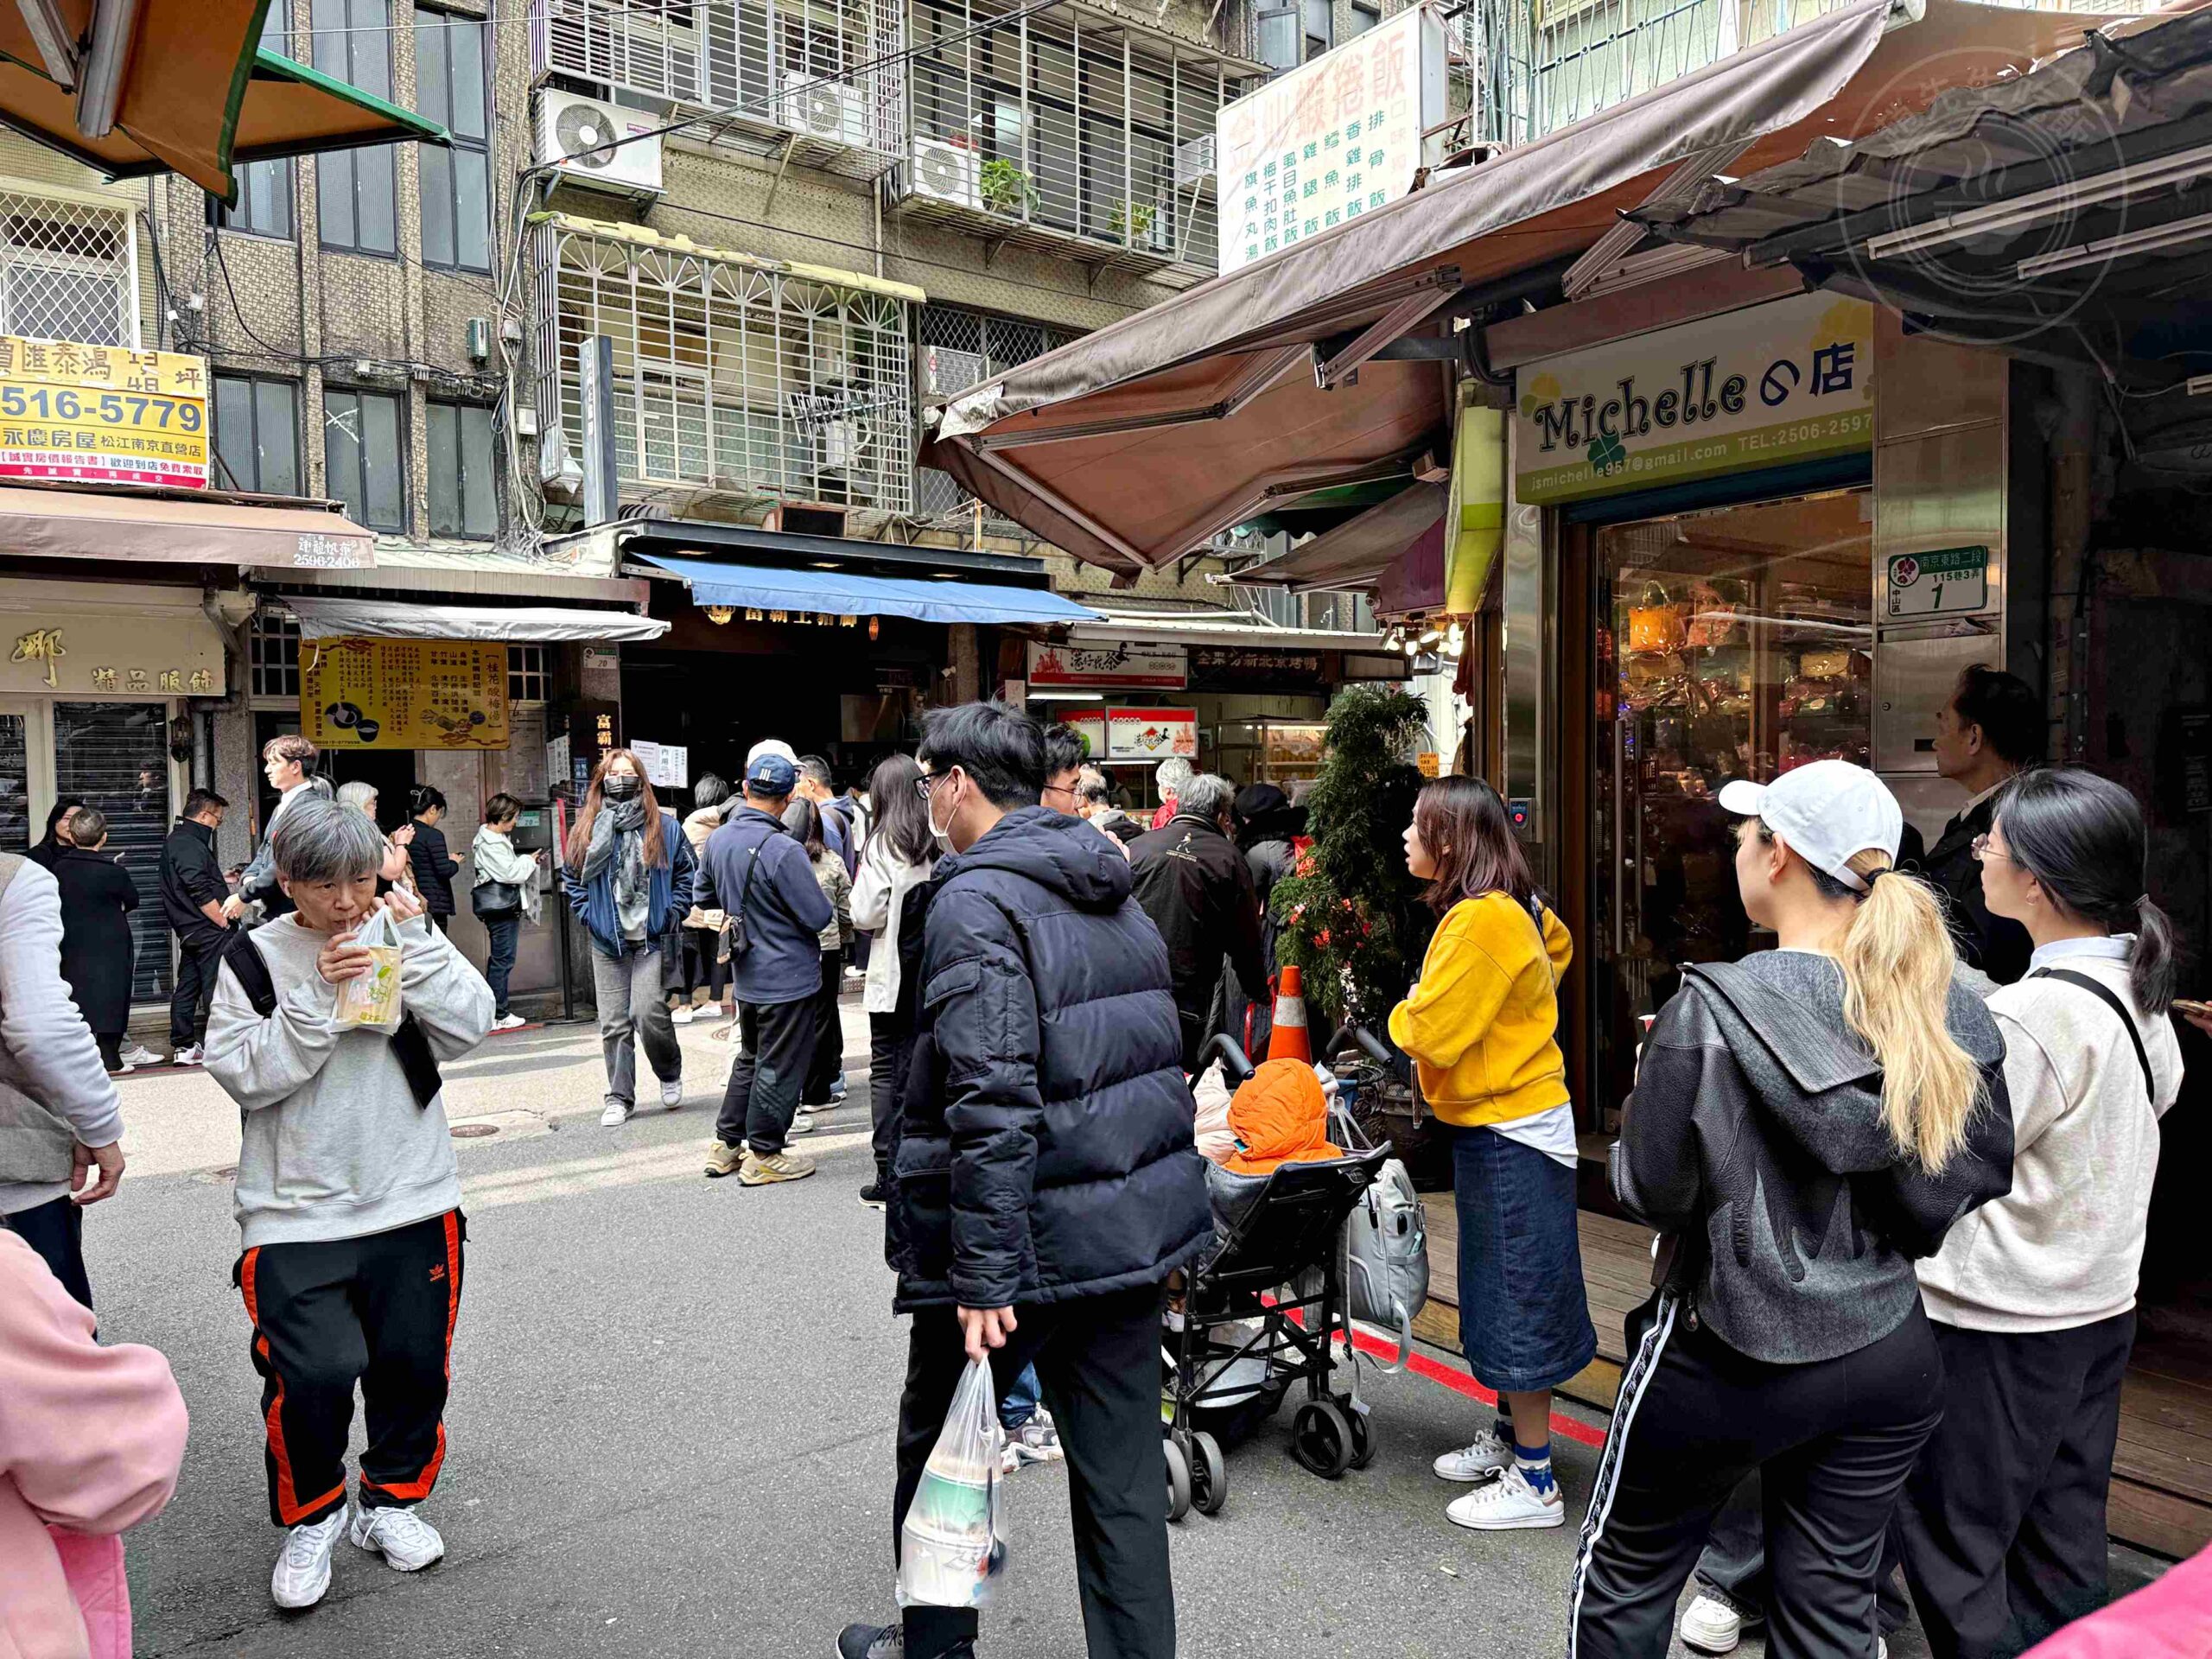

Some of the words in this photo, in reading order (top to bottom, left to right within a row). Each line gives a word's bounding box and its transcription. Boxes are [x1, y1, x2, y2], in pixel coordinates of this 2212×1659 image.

[1345, 120, 1363, 216] 香雞排飯
[1368, 109, 1386, 208] 排骨飯
[1282, 151, 1298, 244] 虱目魚肚飯
[1303, 140, 1319, 237] 雞腿飯
[1243, 172, 1259, 263] 旗魚丸湯
[175, 367, 203, 391] 坪
[1, 386, 201, 432] 516-5779
[1534, 355, 1748, 453] Michelle
[3, 428, 97, 449] 永慶房屋
[101, 435, 201, 458] 松江南京直營店
[1738, 412, 1872, 453] TEL:2506-2597
[1920, 550, 1981, 569] 南京東路二段
[1933, 569, 1980, 583] 115巷3弄
[1891, 588, 1901, 613] 中山區
[1931, 582, 1943, 609] 1
[92, 667, 214, 692] 精品服飾
[597, 659, 608, 668] 20
